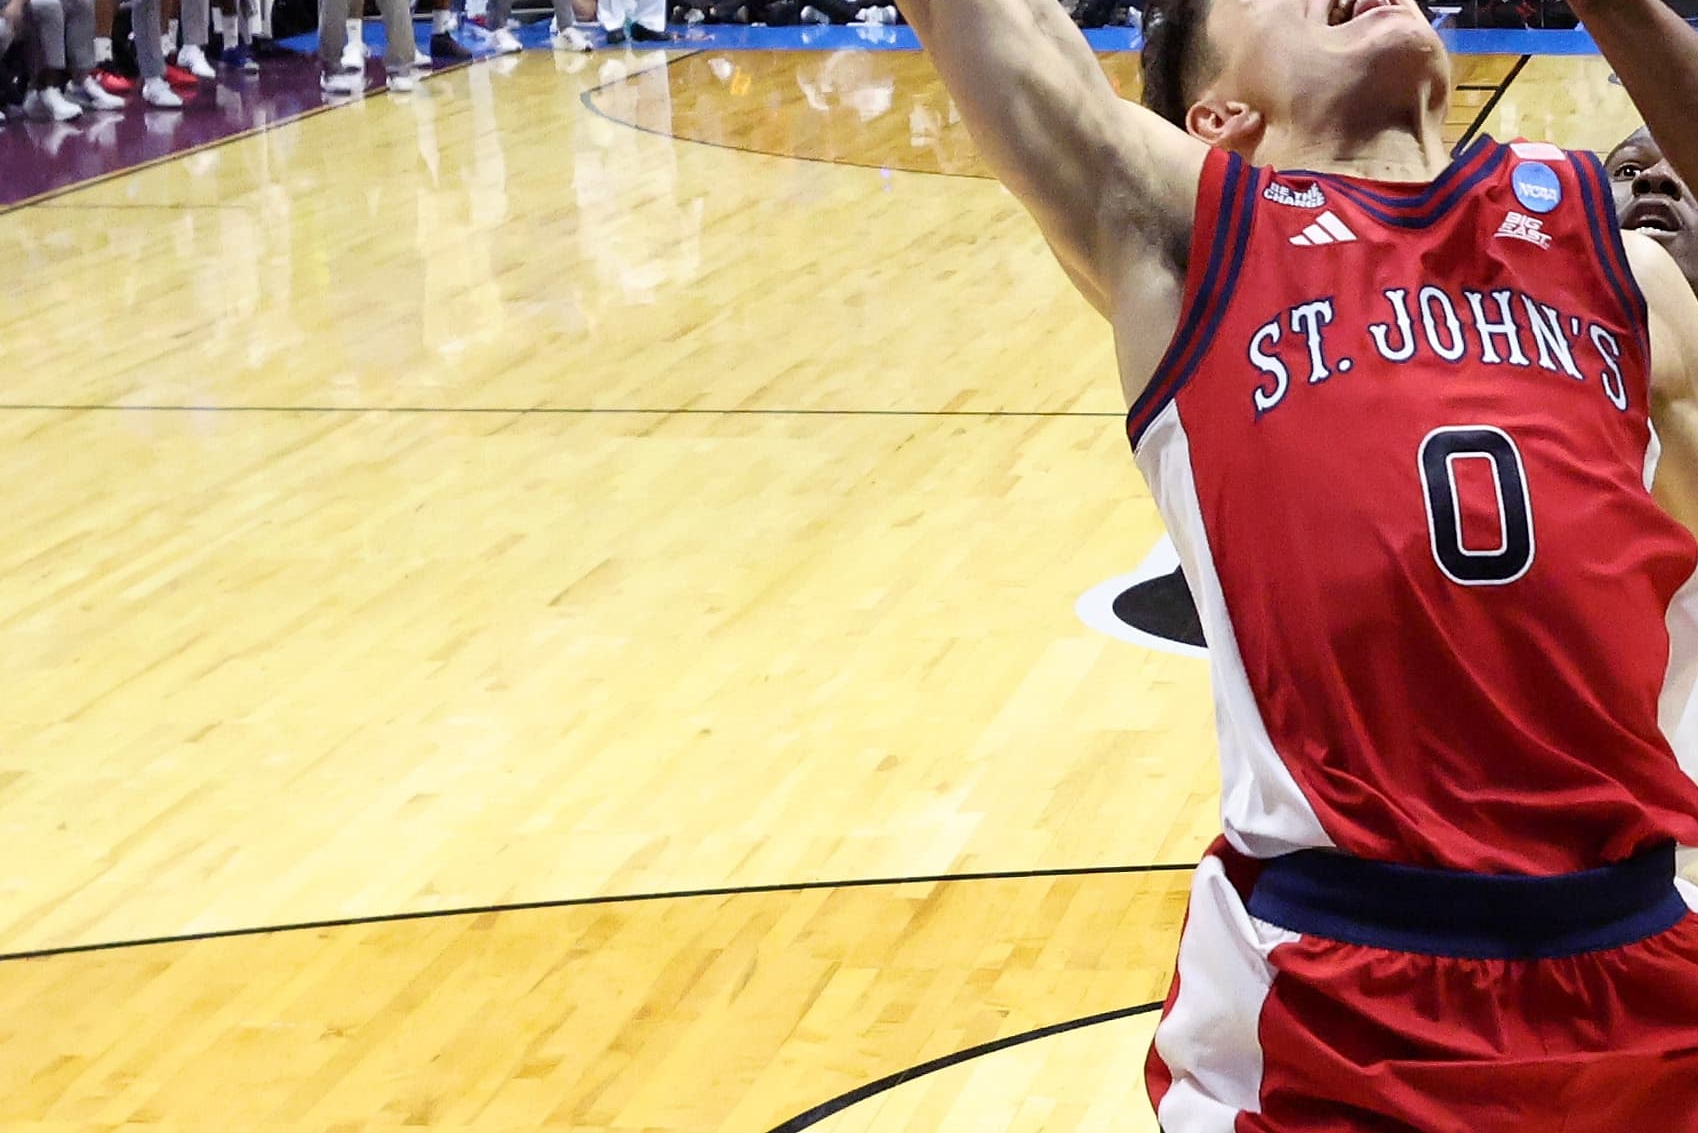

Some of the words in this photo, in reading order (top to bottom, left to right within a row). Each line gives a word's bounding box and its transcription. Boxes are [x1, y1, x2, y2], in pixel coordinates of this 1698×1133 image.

[1270, 181, 1290, 196] BE
[1518, 181, 1560, 203] NCAA
[1505, 211, 1544, 230] BIG
[1499, 222, 1553, 243] EAST
[1248, 298, 1354, 420] ST.
[1368, 285, 1630, 414] JOHN'S
[1417, 424, 1536, 586] 0
